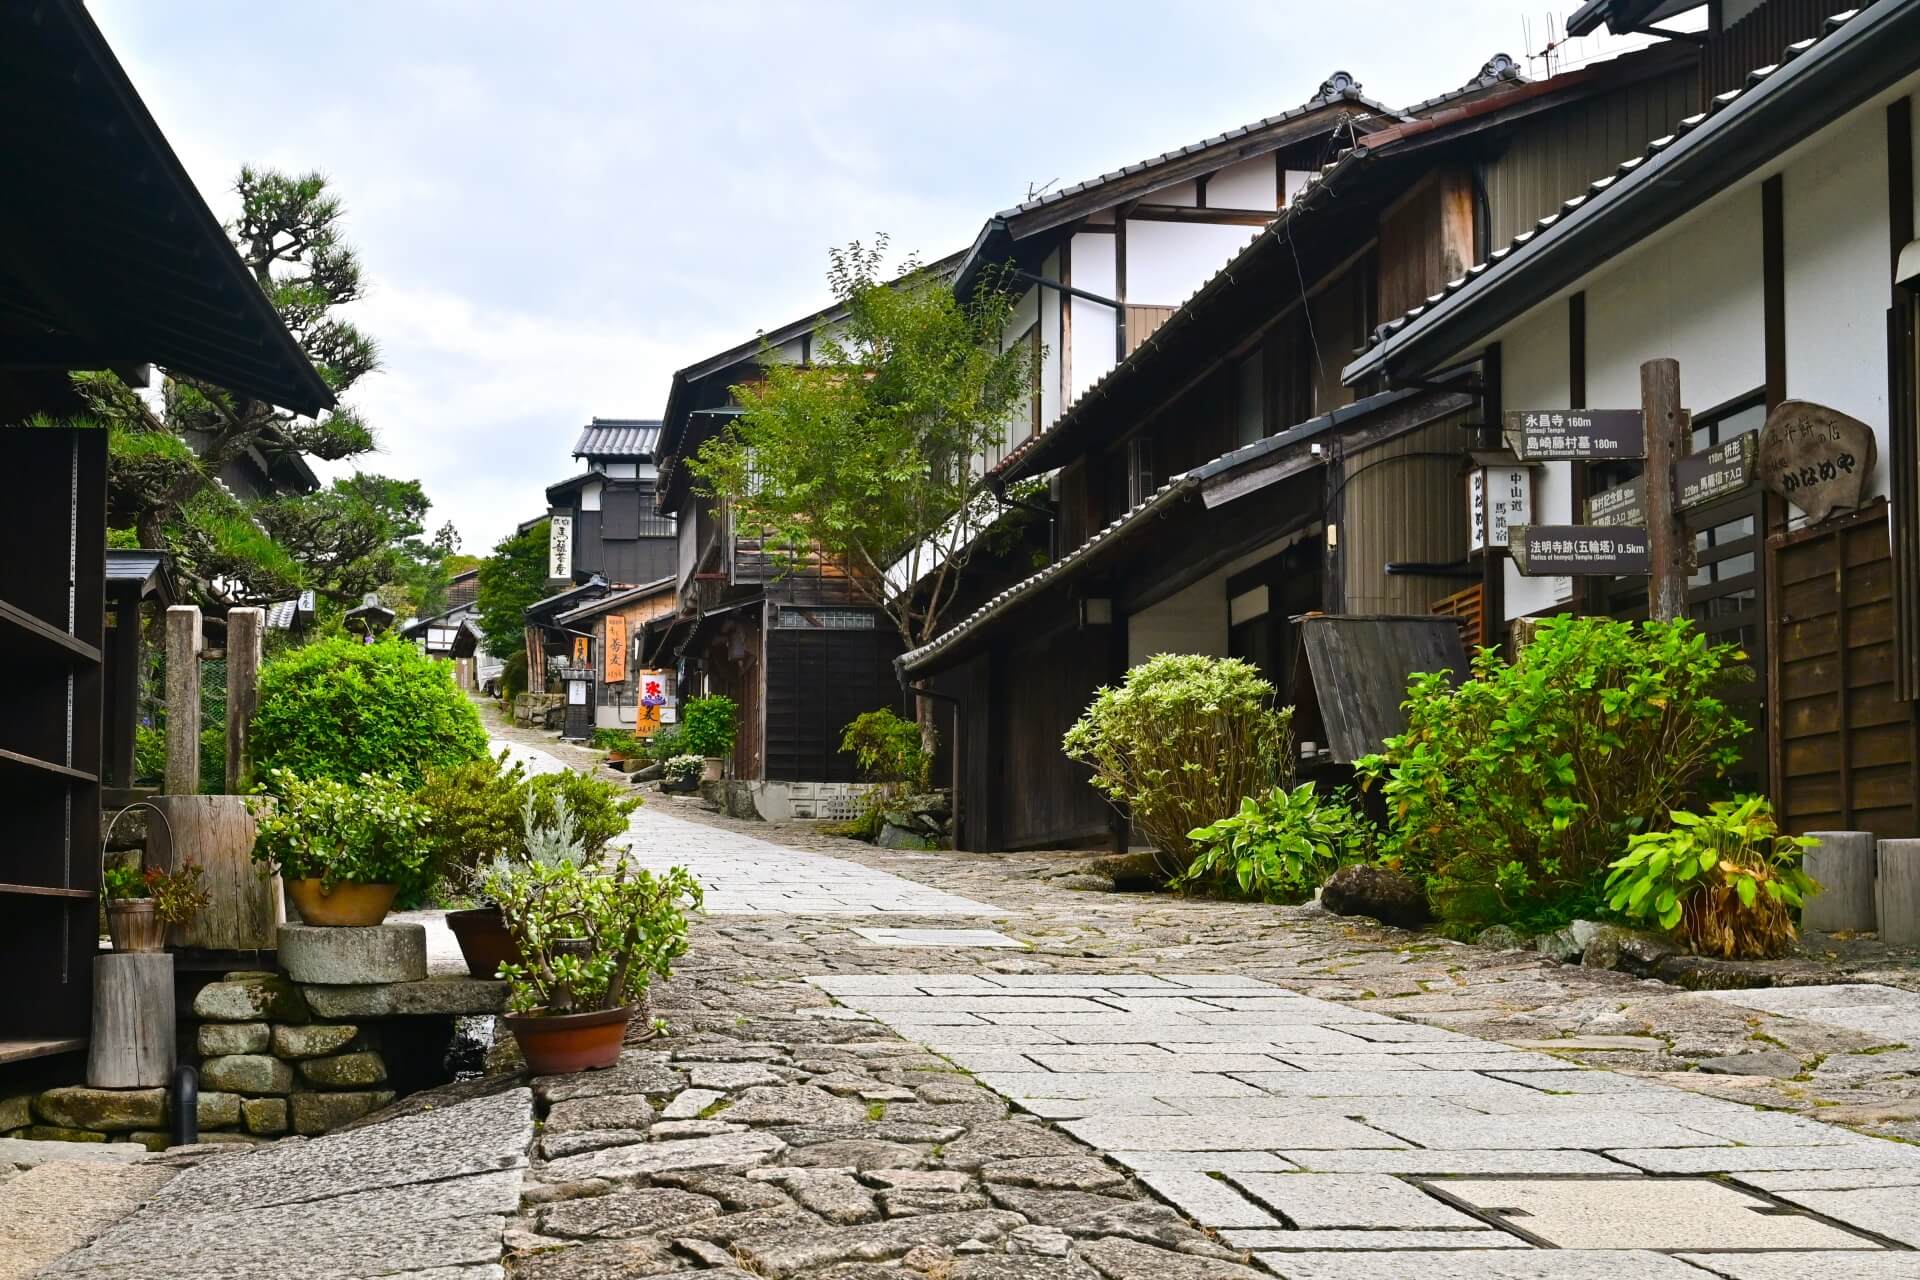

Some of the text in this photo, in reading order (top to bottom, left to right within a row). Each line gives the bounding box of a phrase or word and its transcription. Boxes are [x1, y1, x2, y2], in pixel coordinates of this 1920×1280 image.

[1526, 414, 1592, 427] 永昌寺 160m
[1527, 436, 1618, 449] 島崎藤村墓 180m
[1783, 452, 1856, 493] かなめや
[1511, 472, 1522, 512] 中山道
[1475, 476, 1483, 542] かなめや
[1617, 543, 1645, 554] 0.5km
